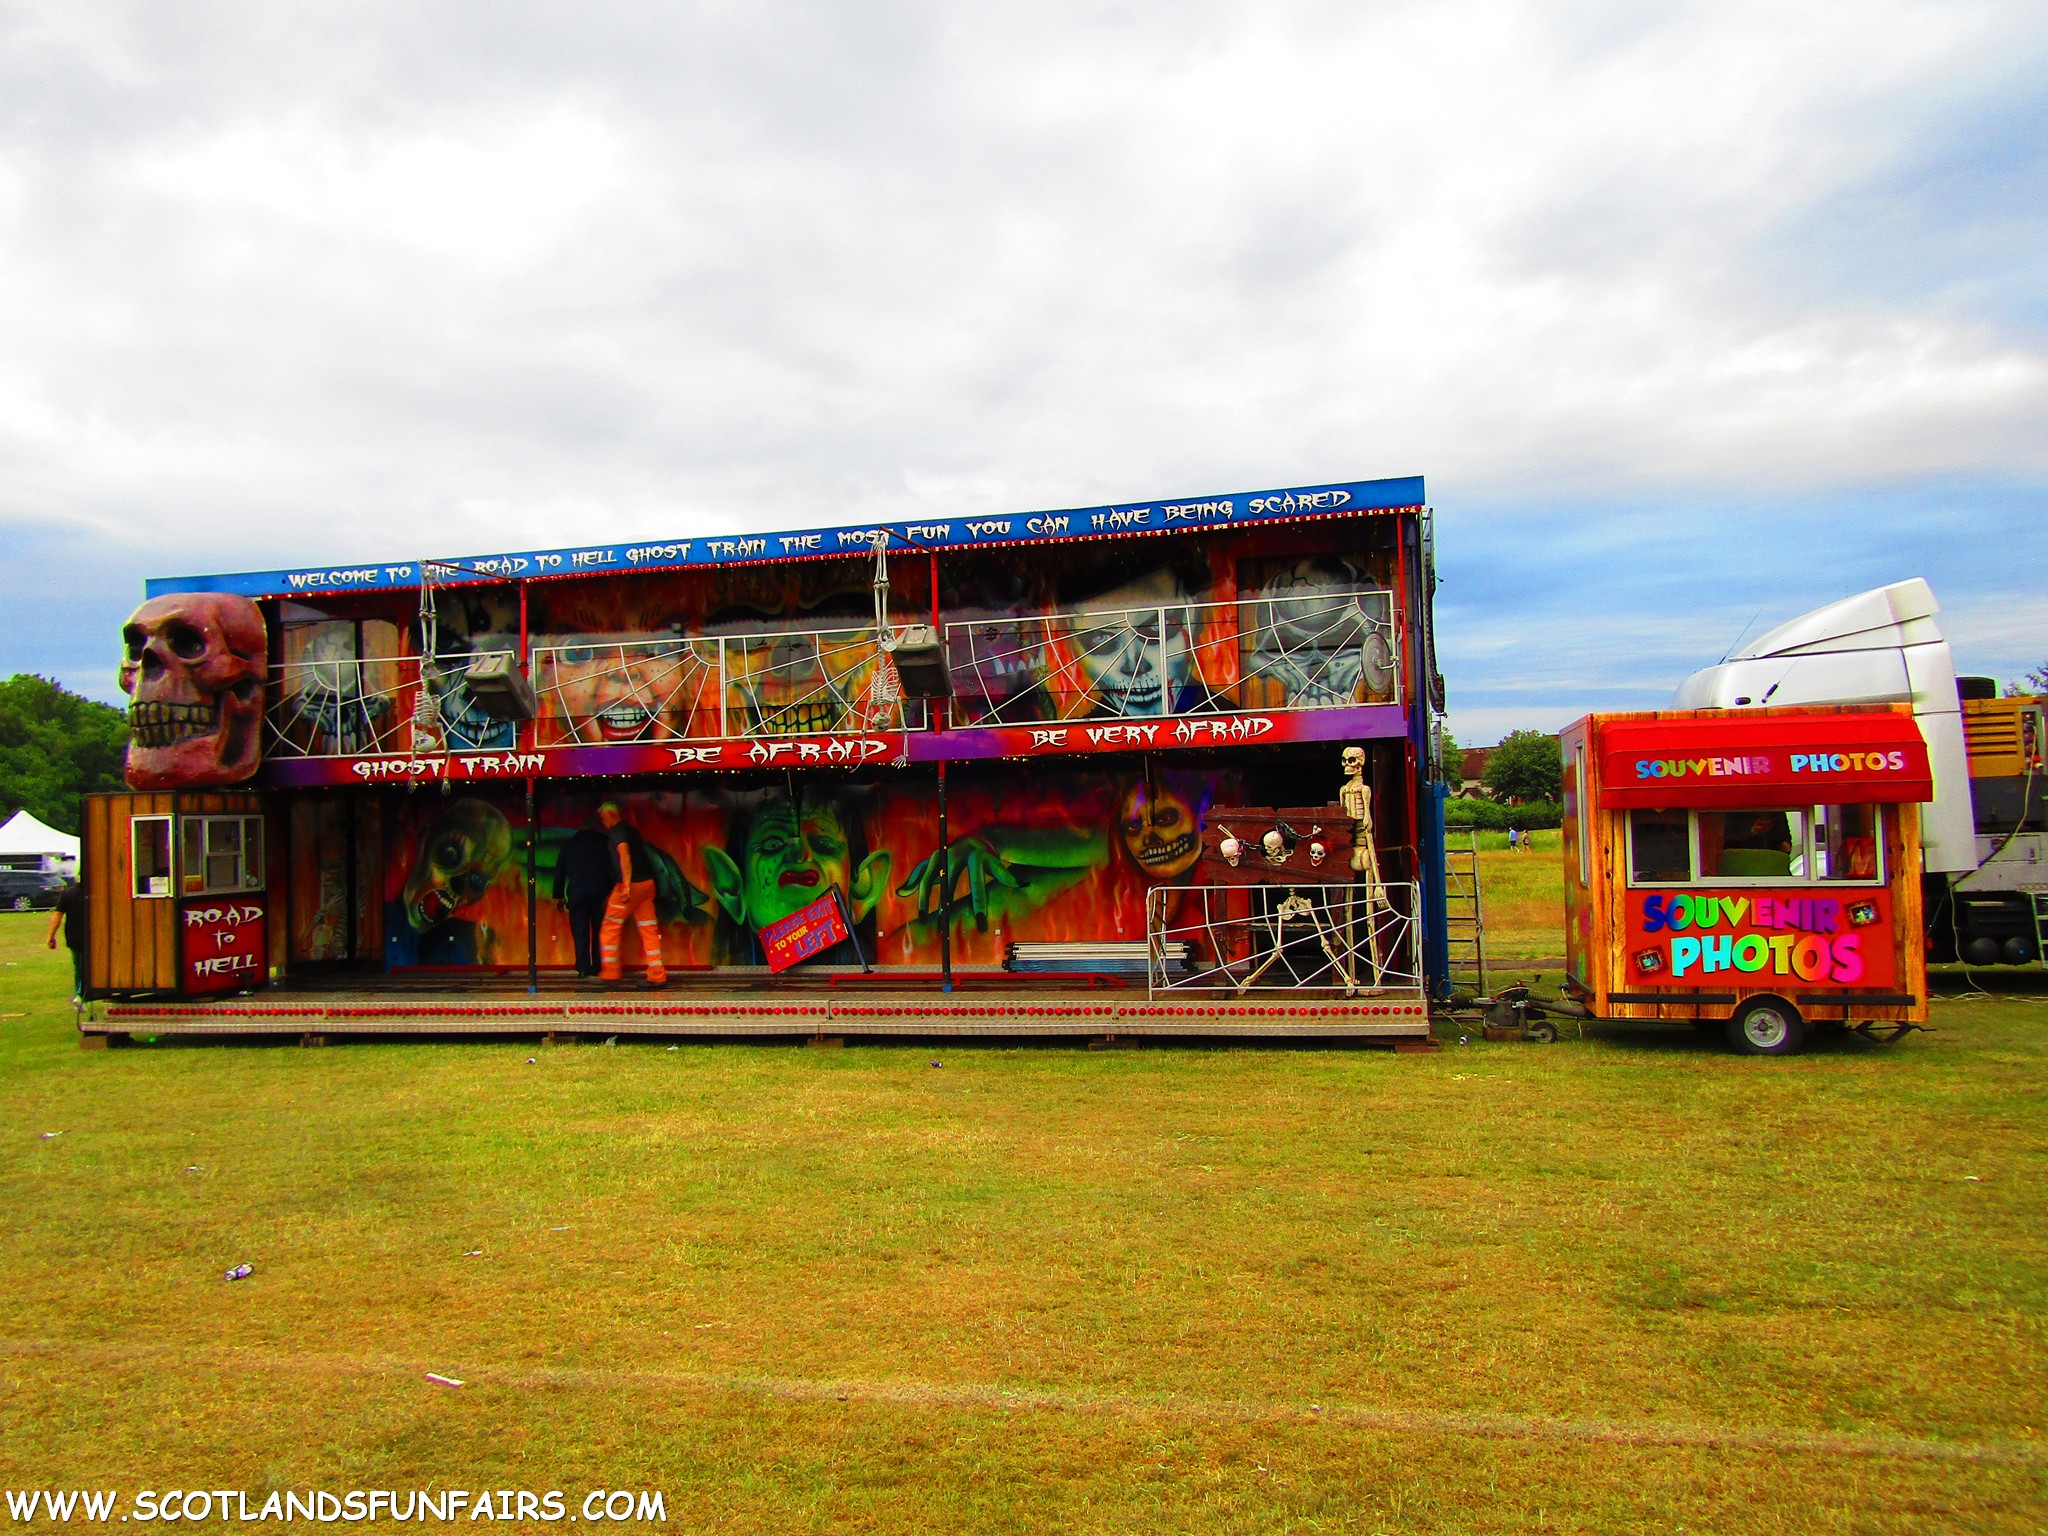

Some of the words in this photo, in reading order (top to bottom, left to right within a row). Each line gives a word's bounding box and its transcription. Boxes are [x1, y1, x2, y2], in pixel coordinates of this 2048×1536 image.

[288, 568, 378, 588] WELCOME
[385, 566, 412, 583] TO
[472, 555, 529, 577] ROAD
[534, 554, 562, 571] TO
[572, 550, 617, 567] HELL
[625, 543, 692, 565] GHOST
[707, 536, 766, 559] TRAIN
[778, 534, 822, 555] THE
[836, 528, 894, 548] MOST
[906, 525, 950, 540] FUN
[965, 521, 1012, 540] YOU
[1026, 513, 1070, 536] CAN
[1090, 507, 1151, 531] HAVE
[1160, 500, 1234, 523] BEING
[1248, 491, 1352, 515] SCARED
[1027, 729, 1068, 749] BE
[1085, 725, 1160, 746] VERY
[1169, 715, 1274, 744] AFRAID
[352, 757, 446, 779] GHOST
[459, 752, 546, 775] TRAIN
[666, 746, 722, 766] BE
[742, 737, 888, 765] AFRAID
[1635, 756, 1771, 779] SOUVENIR
[1790, 751, 1904, 772] PHOTOS
[183, 904, 264, 928] ROAD
[764, 912, 805, 947] PLEASE
[805, 899, 834, 921] EXIT
[1643, 894, 1840, 933] SOUVENIR
[774, 940, 787, 951] TO
[786, 925, 809, 943] YOUR
[794, 918, 837, 959] LEFT
[193, 954, 259, 977] HELL
[1670, 934, 1864, 983] PHOTOS
